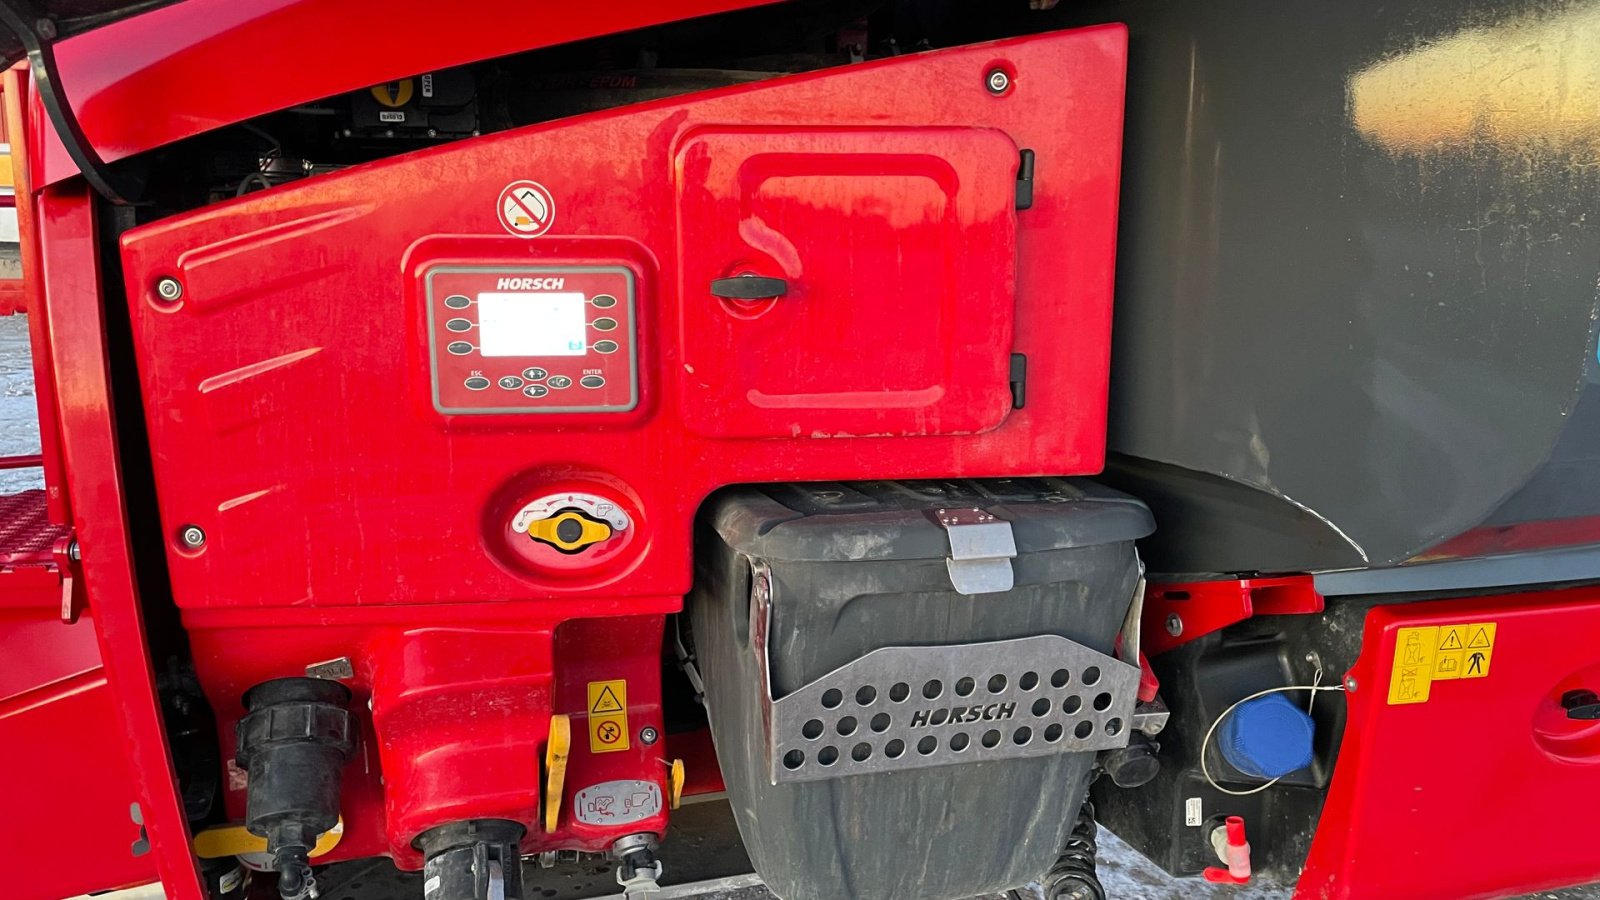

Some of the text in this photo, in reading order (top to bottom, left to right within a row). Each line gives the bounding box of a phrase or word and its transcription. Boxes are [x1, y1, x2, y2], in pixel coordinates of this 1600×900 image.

[496, 277, 565, 290] HORSCH
[582, 368, 603, 376] ENTER
[910, 702, 1018, 729] HORSCH
